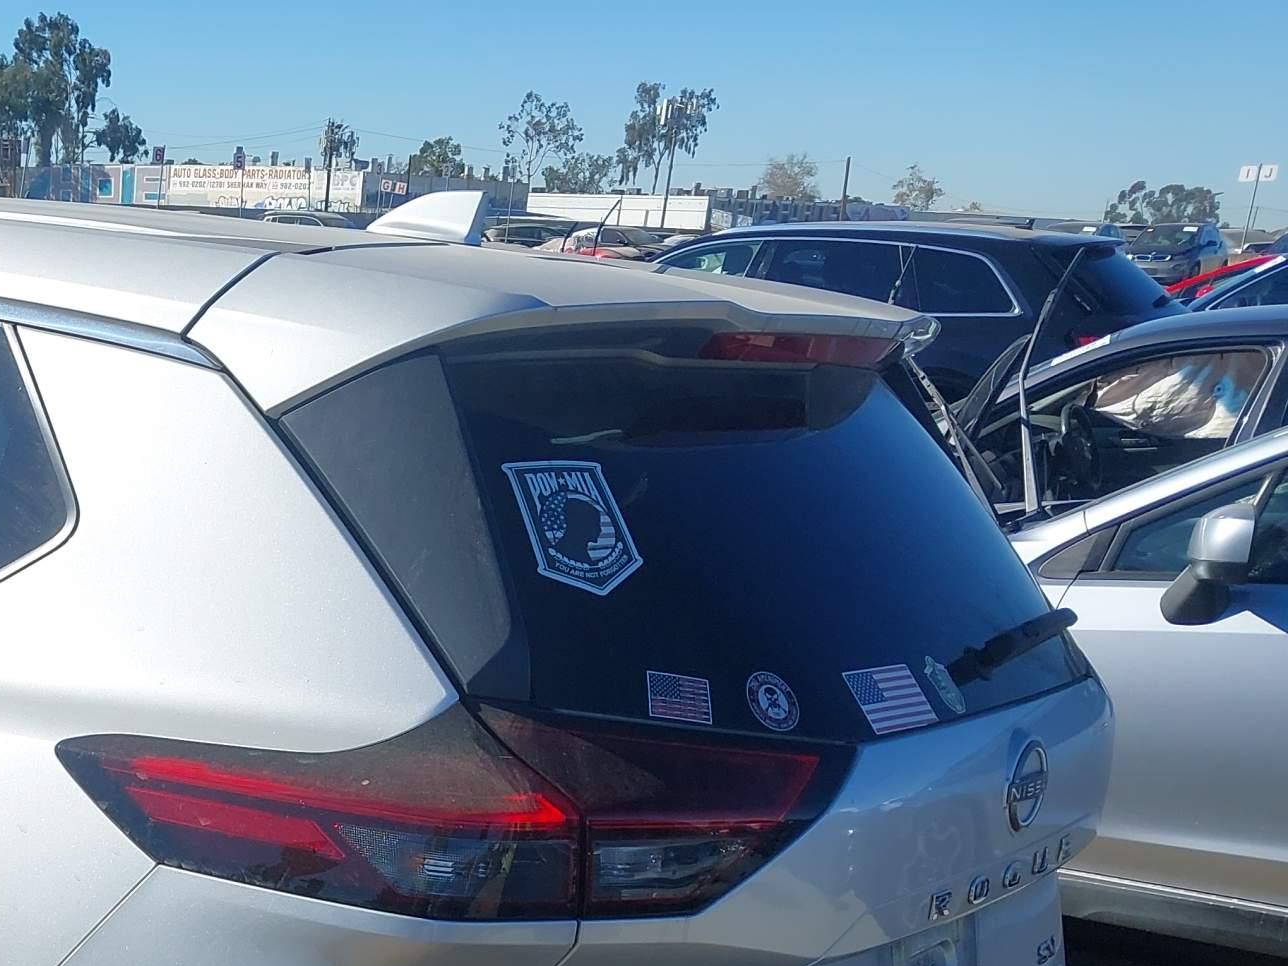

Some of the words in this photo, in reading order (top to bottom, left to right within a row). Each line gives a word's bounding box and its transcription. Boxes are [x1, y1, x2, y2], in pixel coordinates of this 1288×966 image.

[154, 151, 162, 162] 6
[235, 155, 243, 168] 5
[173, 168, 191, 178] AUTO
[1264, 168, 1273, 178] J
[382, 181, 390, 191] G
[398, 184, 406, 194] H
[524, 472, 560, 516] POW
[561, 471, 609, 513] MIA
[555, 561, 570, 574] YOU
[570, 569, 585, 578] ARE
[585, 571, 600, 579] NOT
[1011, 780, 1046, 801] NISS
[927, 832, 1073, 921] ROGUE
